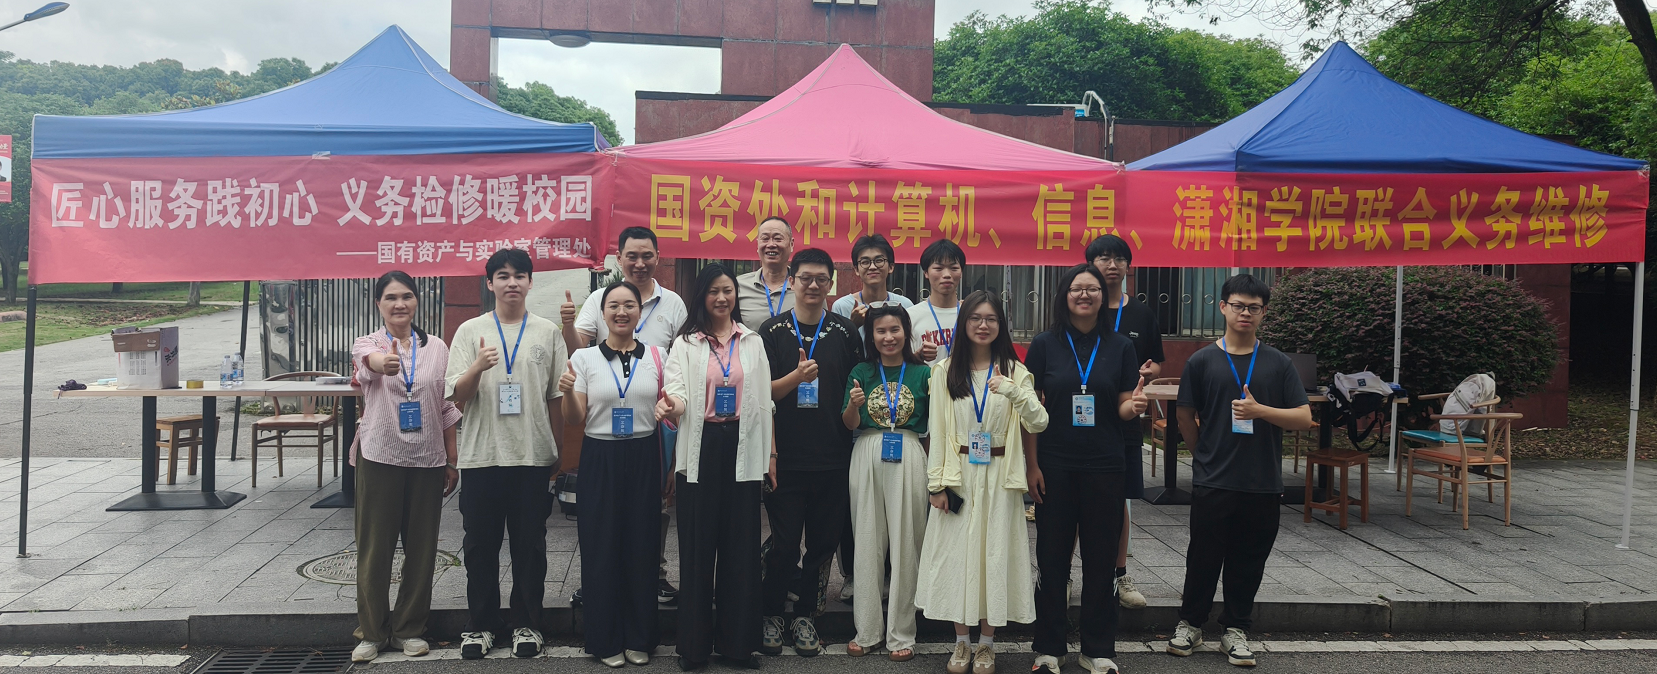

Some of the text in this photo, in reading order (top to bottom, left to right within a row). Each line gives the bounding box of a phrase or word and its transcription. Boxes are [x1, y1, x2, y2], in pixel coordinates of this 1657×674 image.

[51, 174, 593, 230] 匠心服务践初心 义务检修暖校园
[651, 173, 1610, 252] 国资处和计算机、信息、潇湘学院联合义务维修
